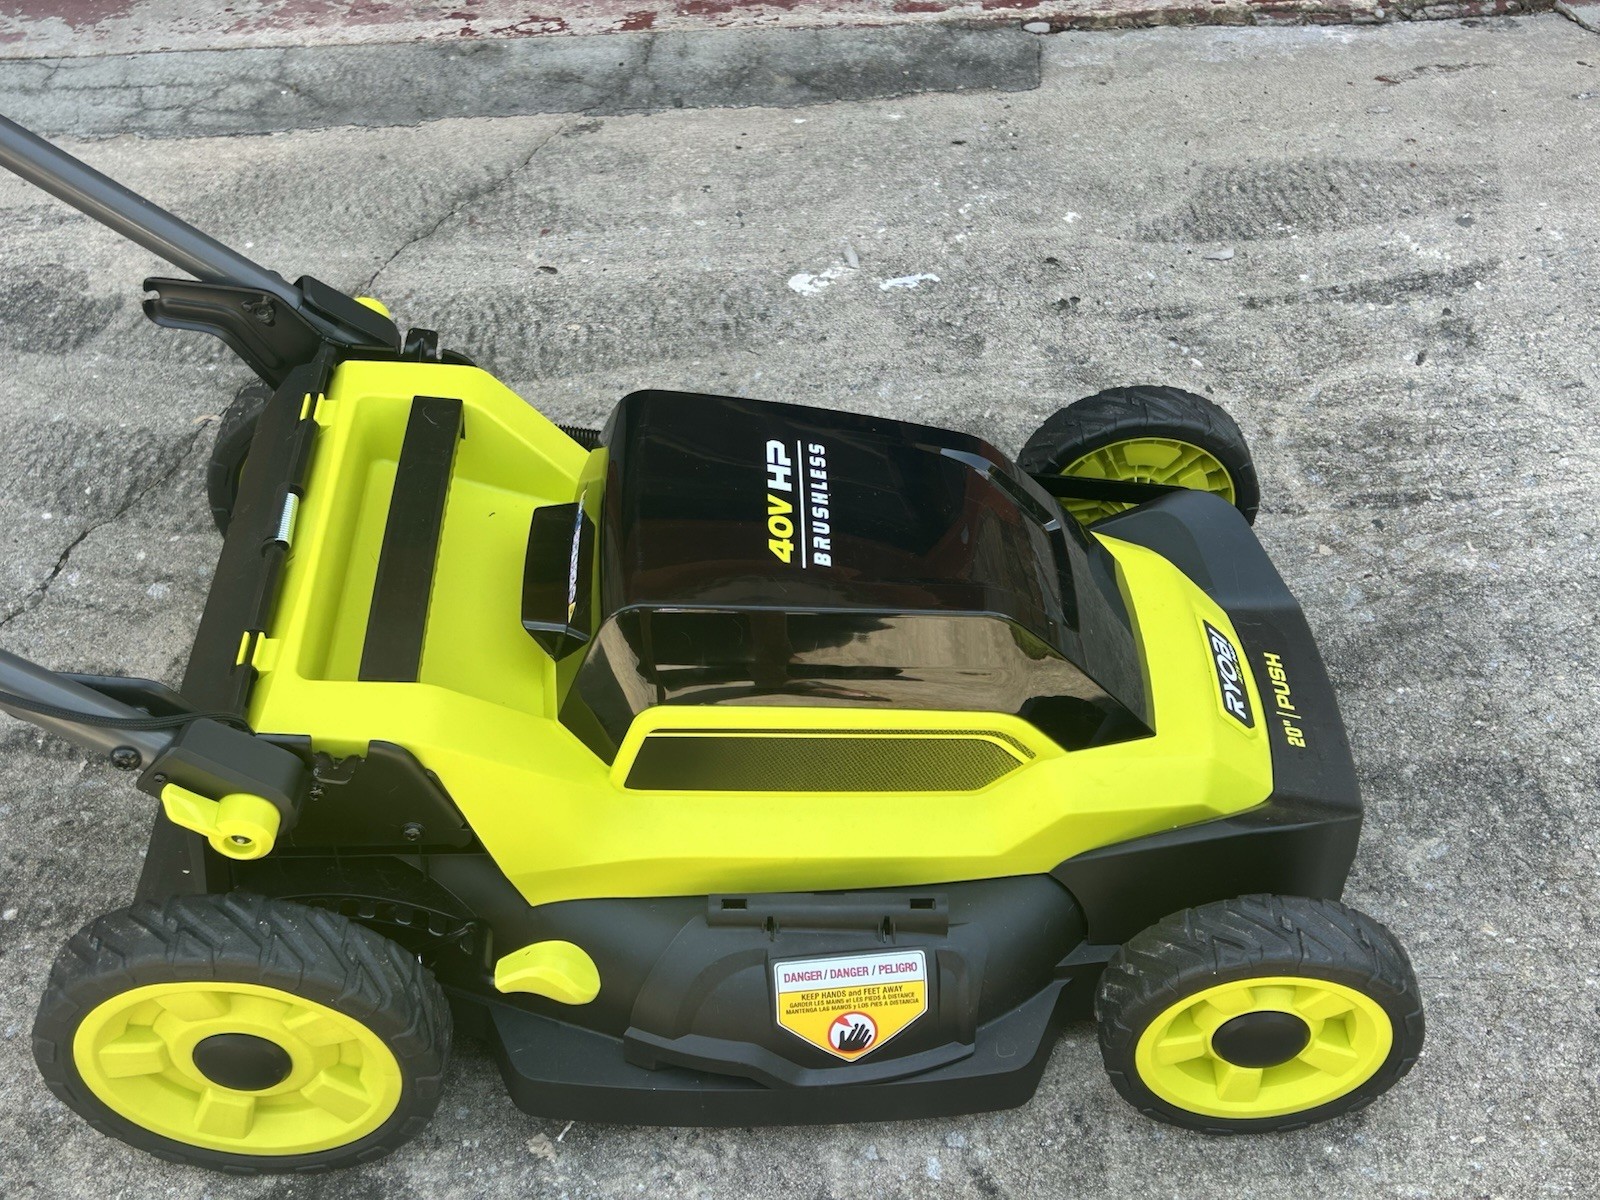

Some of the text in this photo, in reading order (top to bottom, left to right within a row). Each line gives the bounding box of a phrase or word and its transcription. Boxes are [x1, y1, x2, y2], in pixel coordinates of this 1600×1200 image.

[766, 440, 794, 563] 40V HP
[808, 443, 832, 567] BRUSHLESS
[1208, 627, 1247, 719] RYOBI
[1263, 652, 1296, 710] PUSH
[784, 970, 822, 983] DANGER
[830, 966, 869, 979] DANGER
[878, 961, 918, 975] PELIGRO
[785, 1007, 818, 1015] MANTENGA
[831, 1003, 852, 1011] MANOS
[889, 998, 920, 1006] DISTANCIA
[801, 985, 903, 1001] KEEP HANDS and FEET AWAY
[887, 992, 915, 1000] DISTANCE
